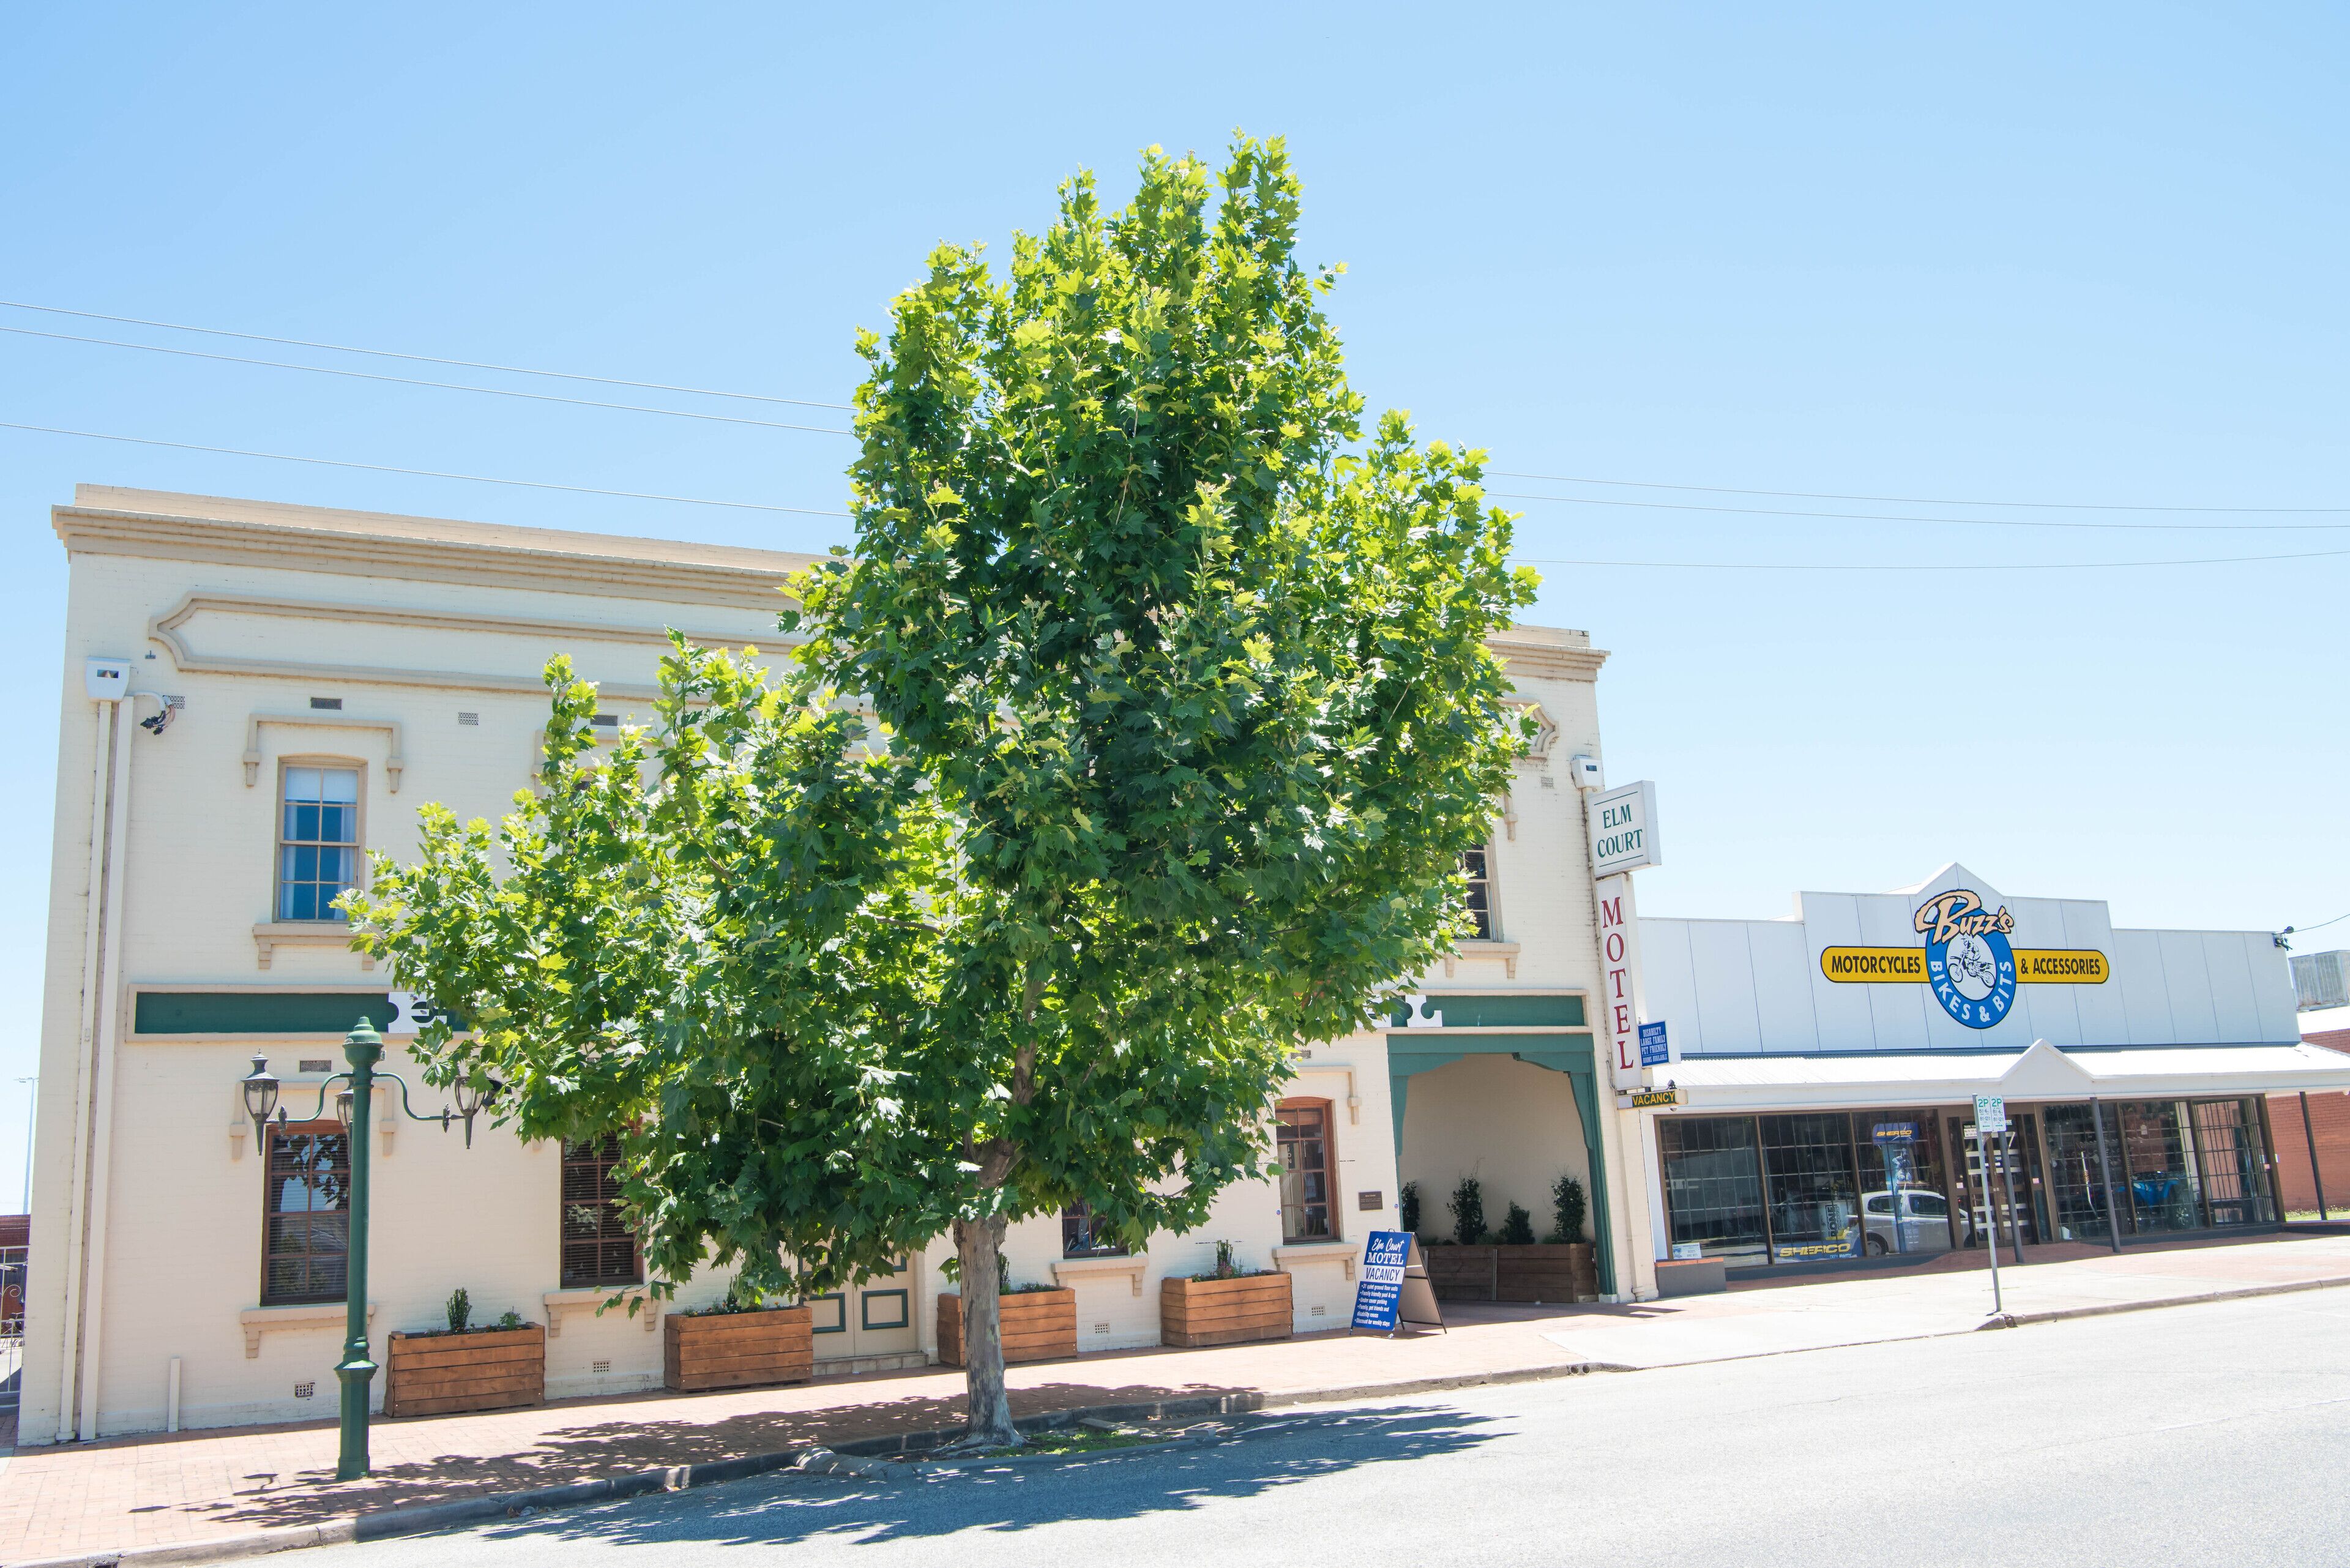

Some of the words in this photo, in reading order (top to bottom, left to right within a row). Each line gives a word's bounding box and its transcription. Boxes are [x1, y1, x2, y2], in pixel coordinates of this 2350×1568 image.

[1602, 804, 1632, 829] ELM
[1597, 829, 1643, 858] COURT
[1914, 889, 2015, 945] Buzz's
[1831, 955, 1921, 974] MOTORCYCLES
[2021, 958, 2029, 974] &
[2033, 958, 2100, 976] ACCESSORIES
[1601, 896, 1633, 1070] MOTEL
[1930, 960, 1971, 1021] BIKES
[1979, 1006, 1991, 1022] &
[1994, 961, 2012, 1012] BITS
[1640, 1037, 1652, 1046] LARGE
[1652, 1034, 1665, 1044] FAMILY
[1649, 1043, 1666, 1053] FRIENDLY
[1632, 1092, 1674, 1105] VACANCY
[1978, 1099, 1988, 1107] 2P
[1991, 1098, 2002, 1107] 2P
[1371, 1238, 1384, 1251] Elm
[1386, 1238, 1404, 1252] Court
[1780, 1243, 1851, 1257] SHERCO
[1367, 1252, 1403, 1265] MOTEL
[1366, 1267, 1400, 1281] VACANCY
